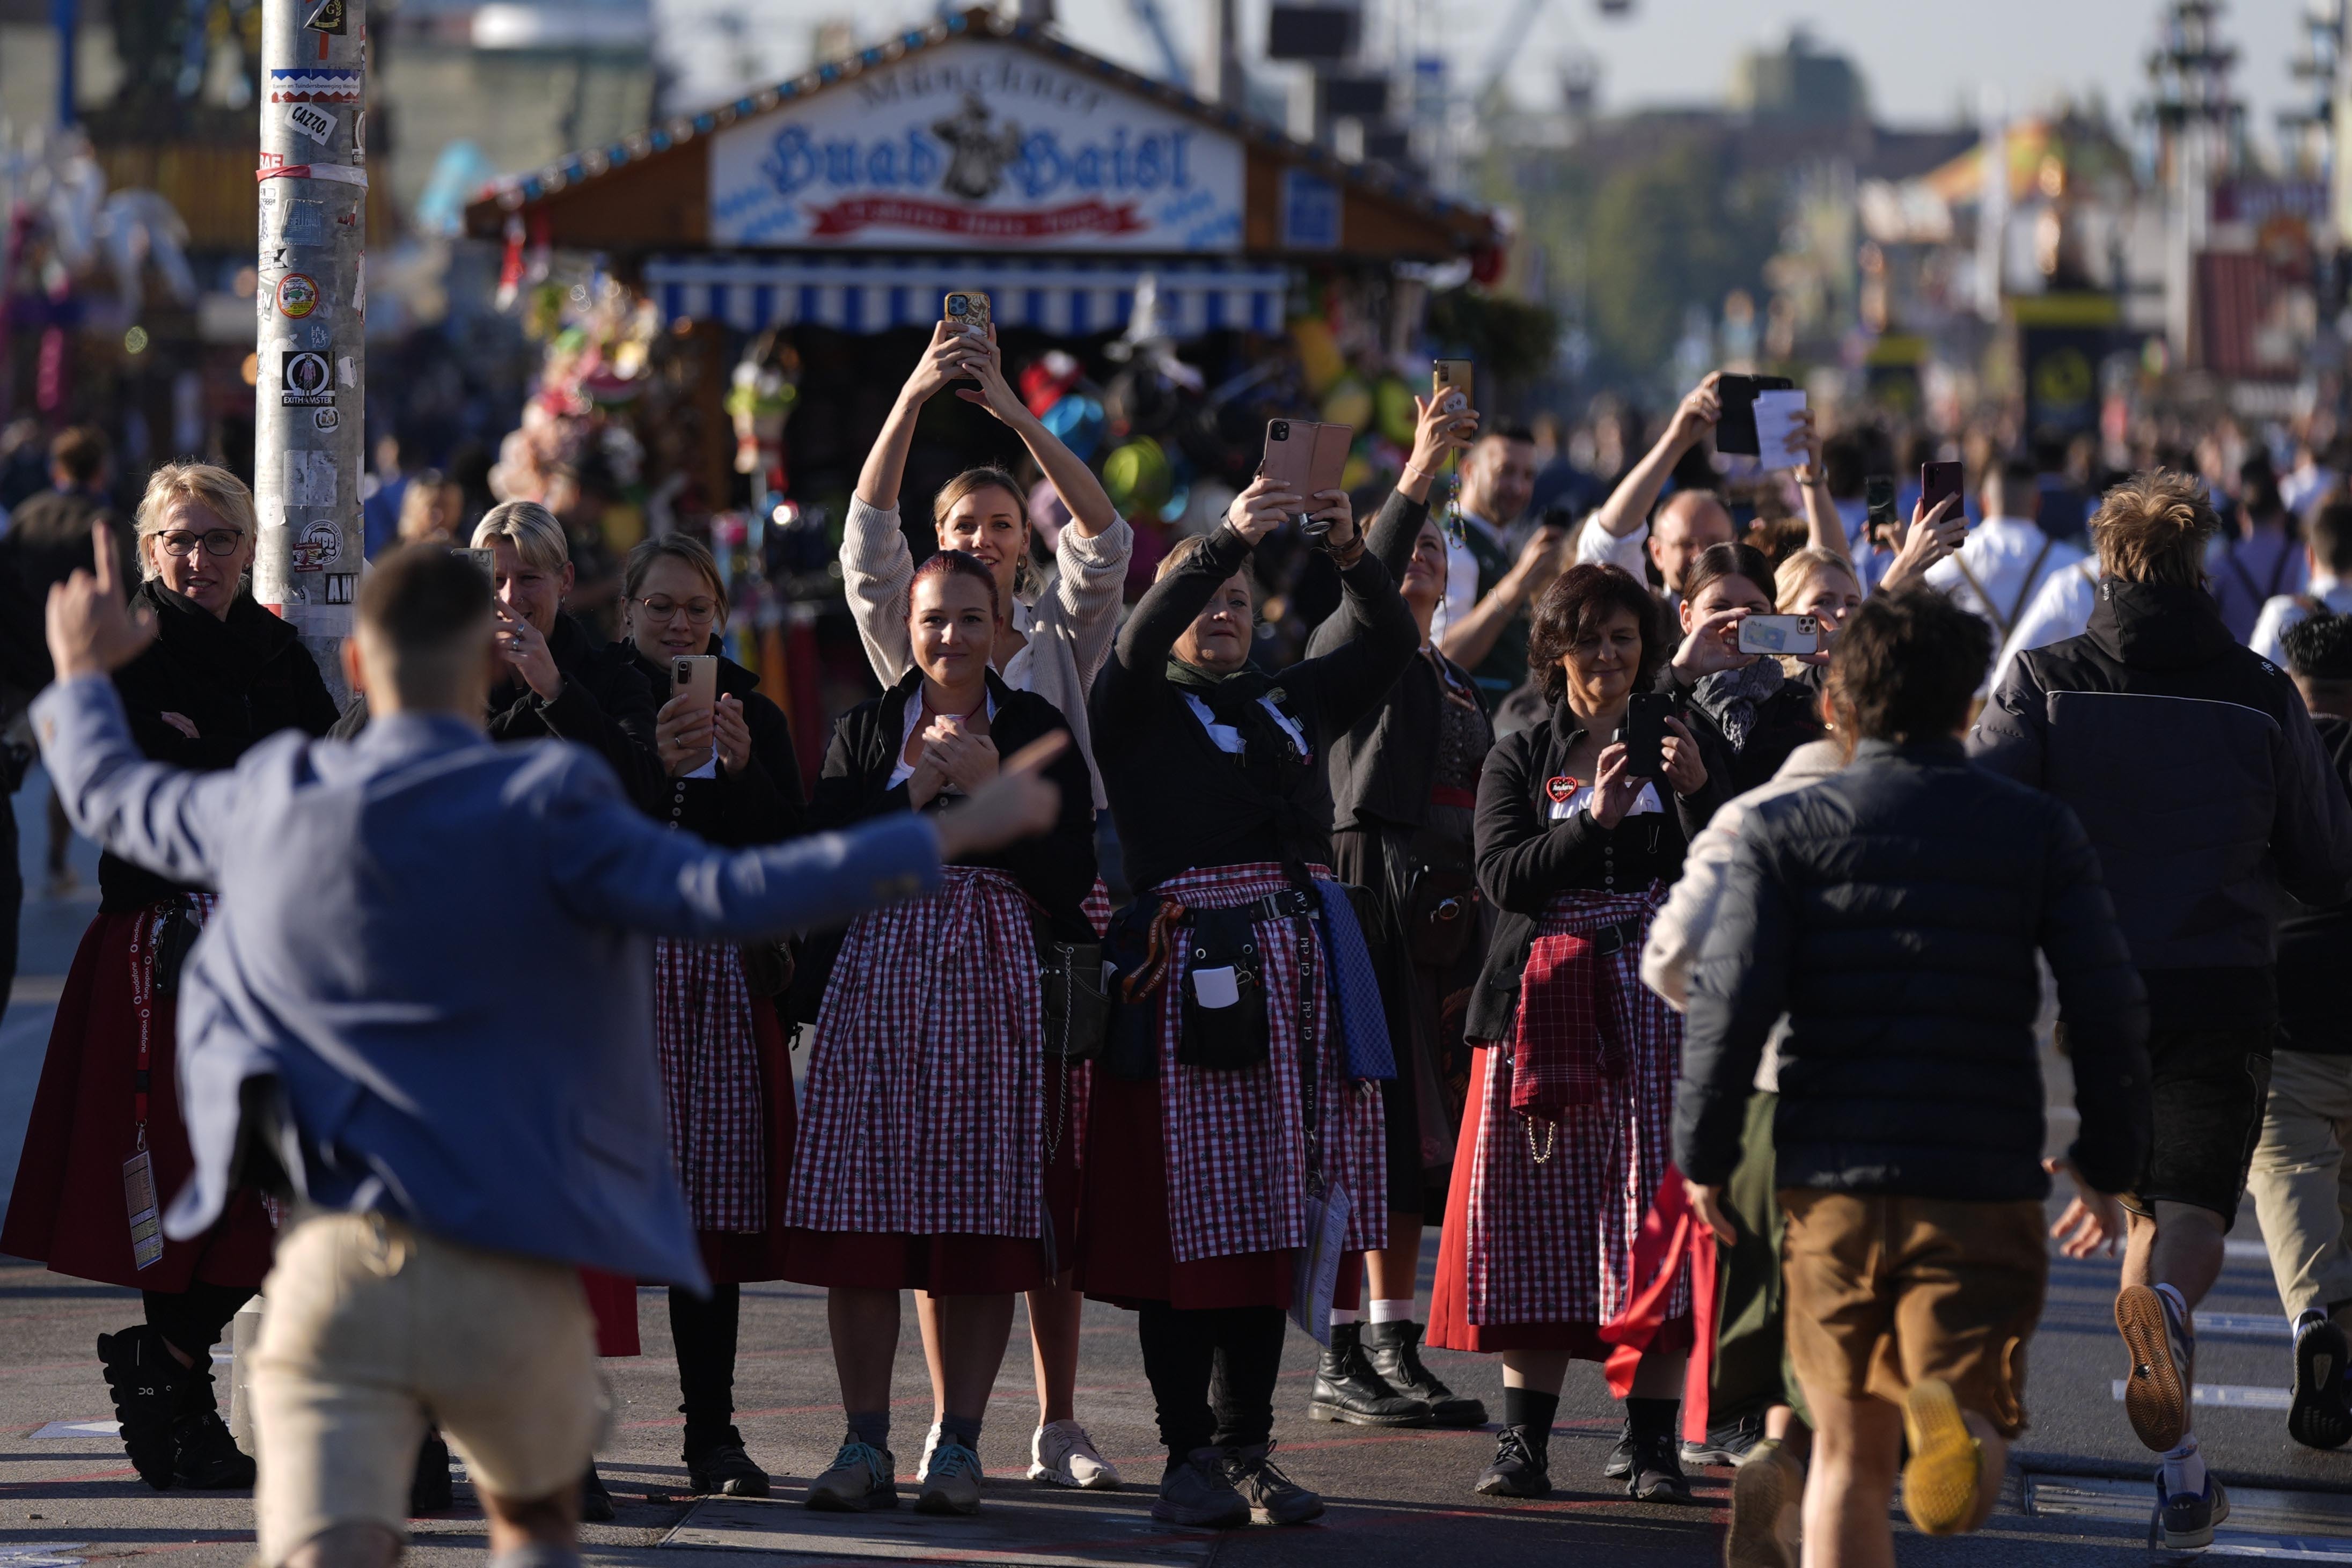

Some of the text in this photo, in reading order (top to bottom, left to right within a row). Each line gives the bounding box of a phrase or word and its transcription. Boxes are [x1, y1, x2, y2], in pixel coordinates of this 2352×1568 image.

[292, 106, 327, 136] CAZZO.
[329, 524, 338, 533] YOUR
[134, 911, 146, 942] vodafon
[1300, 937, 1310, 976] Glckl
[132, 962, 141, 994] vodafone
[1302, 1001, 1313, 1040] Glckl
